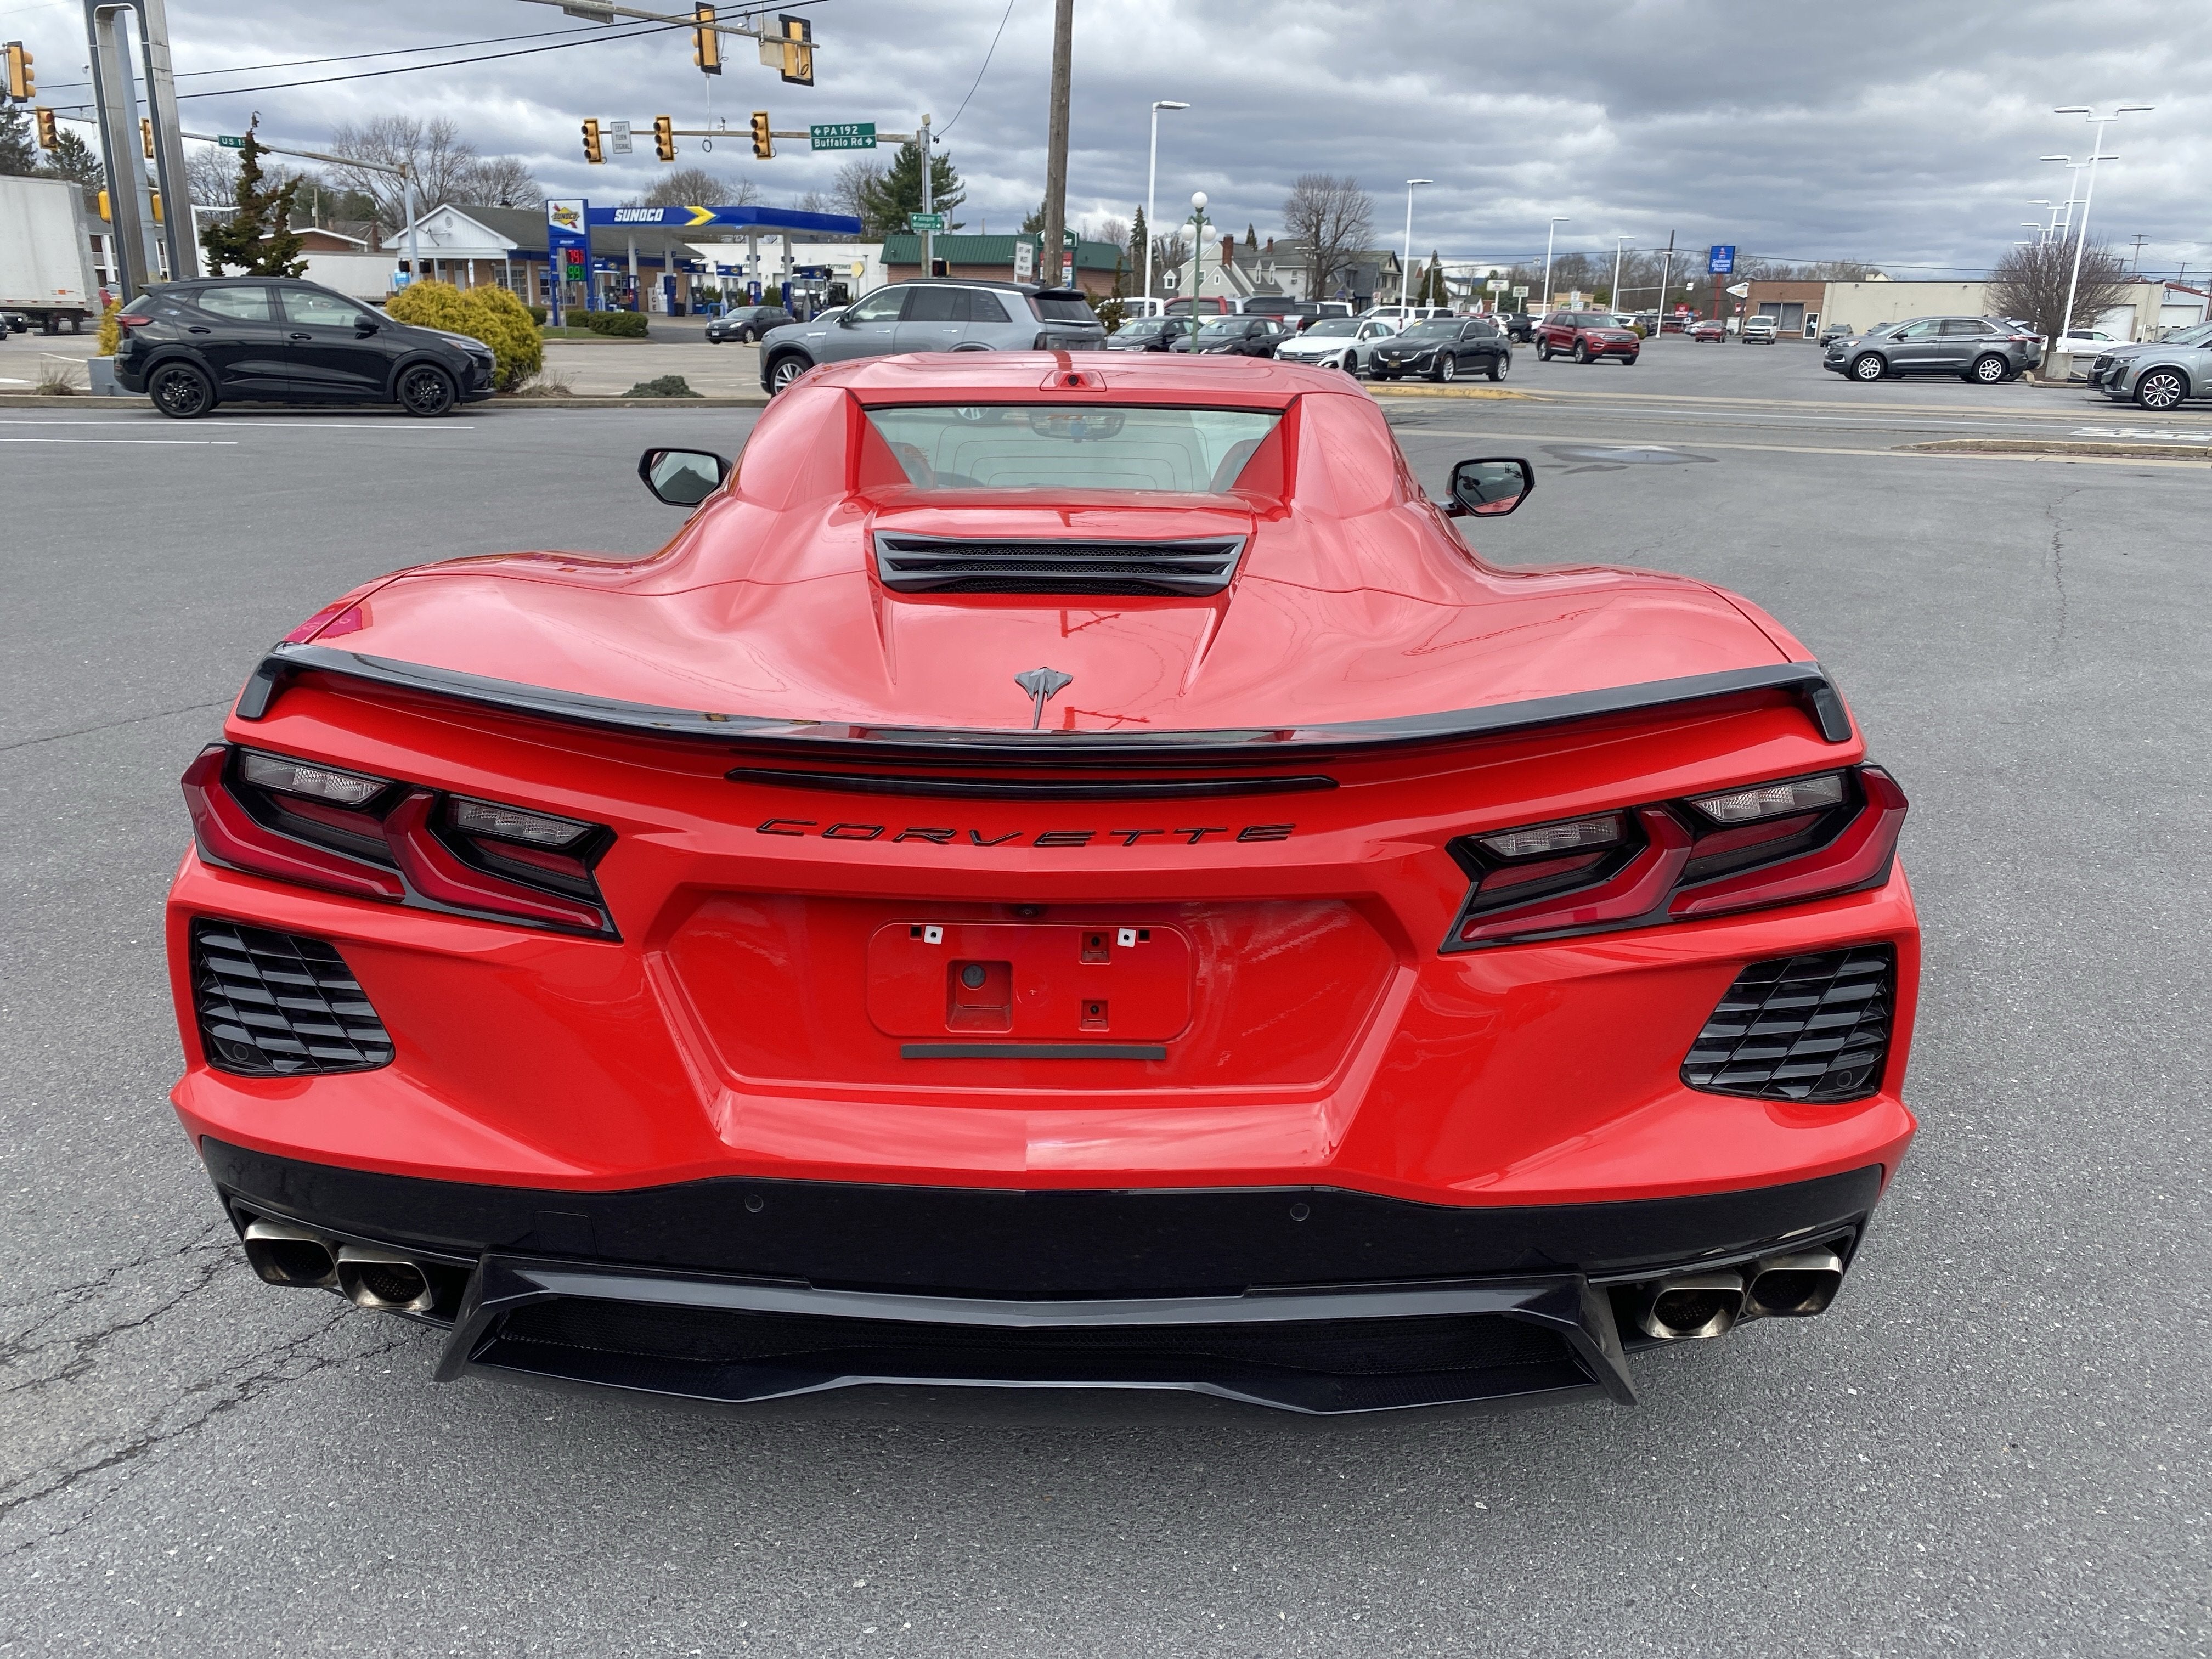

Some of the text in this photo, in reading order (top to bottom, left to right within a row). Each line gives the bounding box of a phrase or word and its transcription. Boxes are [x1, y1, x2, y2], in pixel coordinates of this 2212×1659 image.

[823, 126, 859, 136] PA 192
[814, 137, 863, 148] Buffalo Rd
[614, 208, 664, 222] SUNOCO
[755, 817, 1296, 848] CORVETTE
